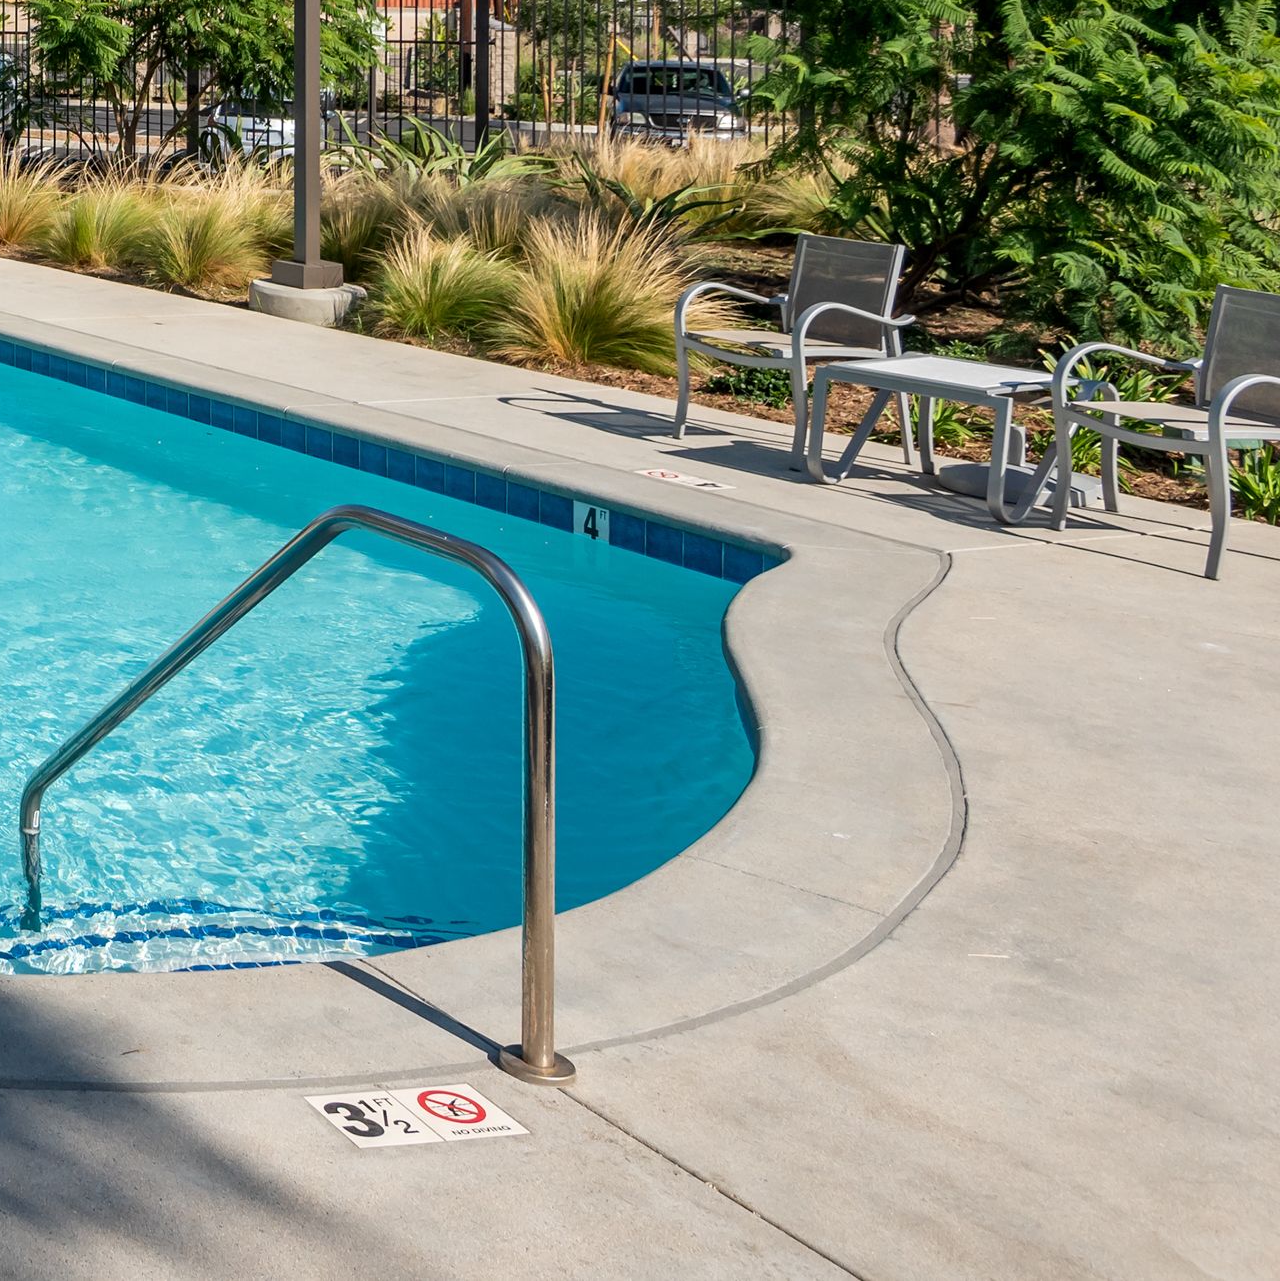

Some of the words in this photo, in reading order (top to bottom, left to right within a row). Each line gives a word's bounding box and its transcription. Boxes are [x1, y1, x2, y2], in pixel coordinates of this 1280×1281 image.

[583, 507, 599, 540] 4
[599, 510, 607, 521] FT
[323, 1102, 385, 1137] 3
[372, 1097, 393, 1107] FT
[471, 1125, 511, 1134] DIVING
